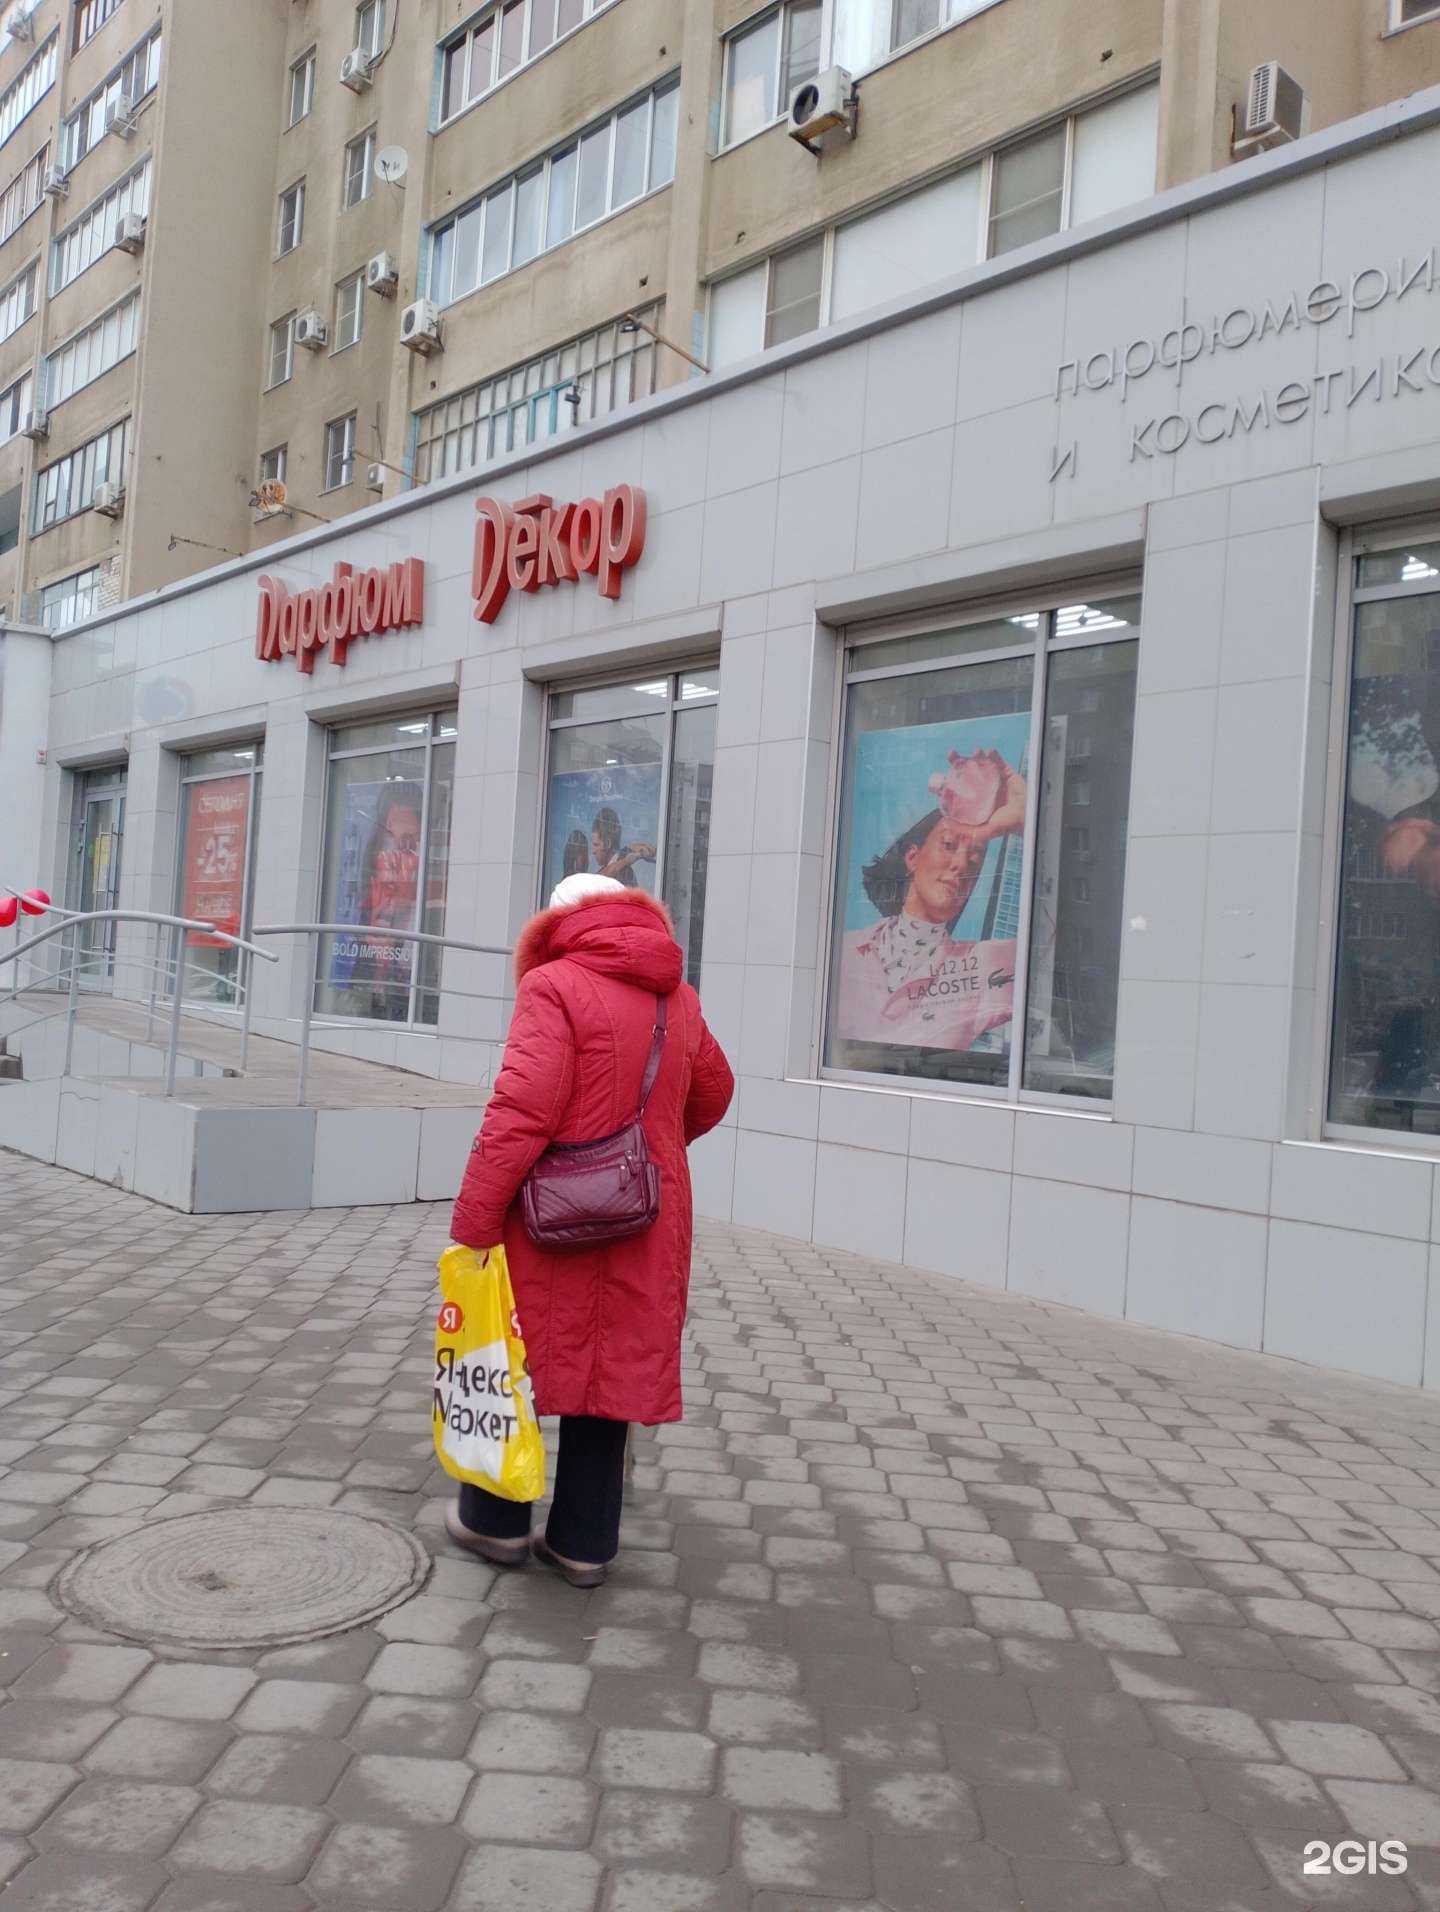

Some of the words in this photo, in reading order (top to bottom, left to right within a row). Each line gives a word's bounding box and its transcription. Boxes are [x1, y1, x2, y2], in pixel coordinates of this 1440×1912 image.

[1049, 440, 1078, 482] и
[332, 943, 358, 957] BOLD
[907, 976, 980, 1000] LACOSTE
